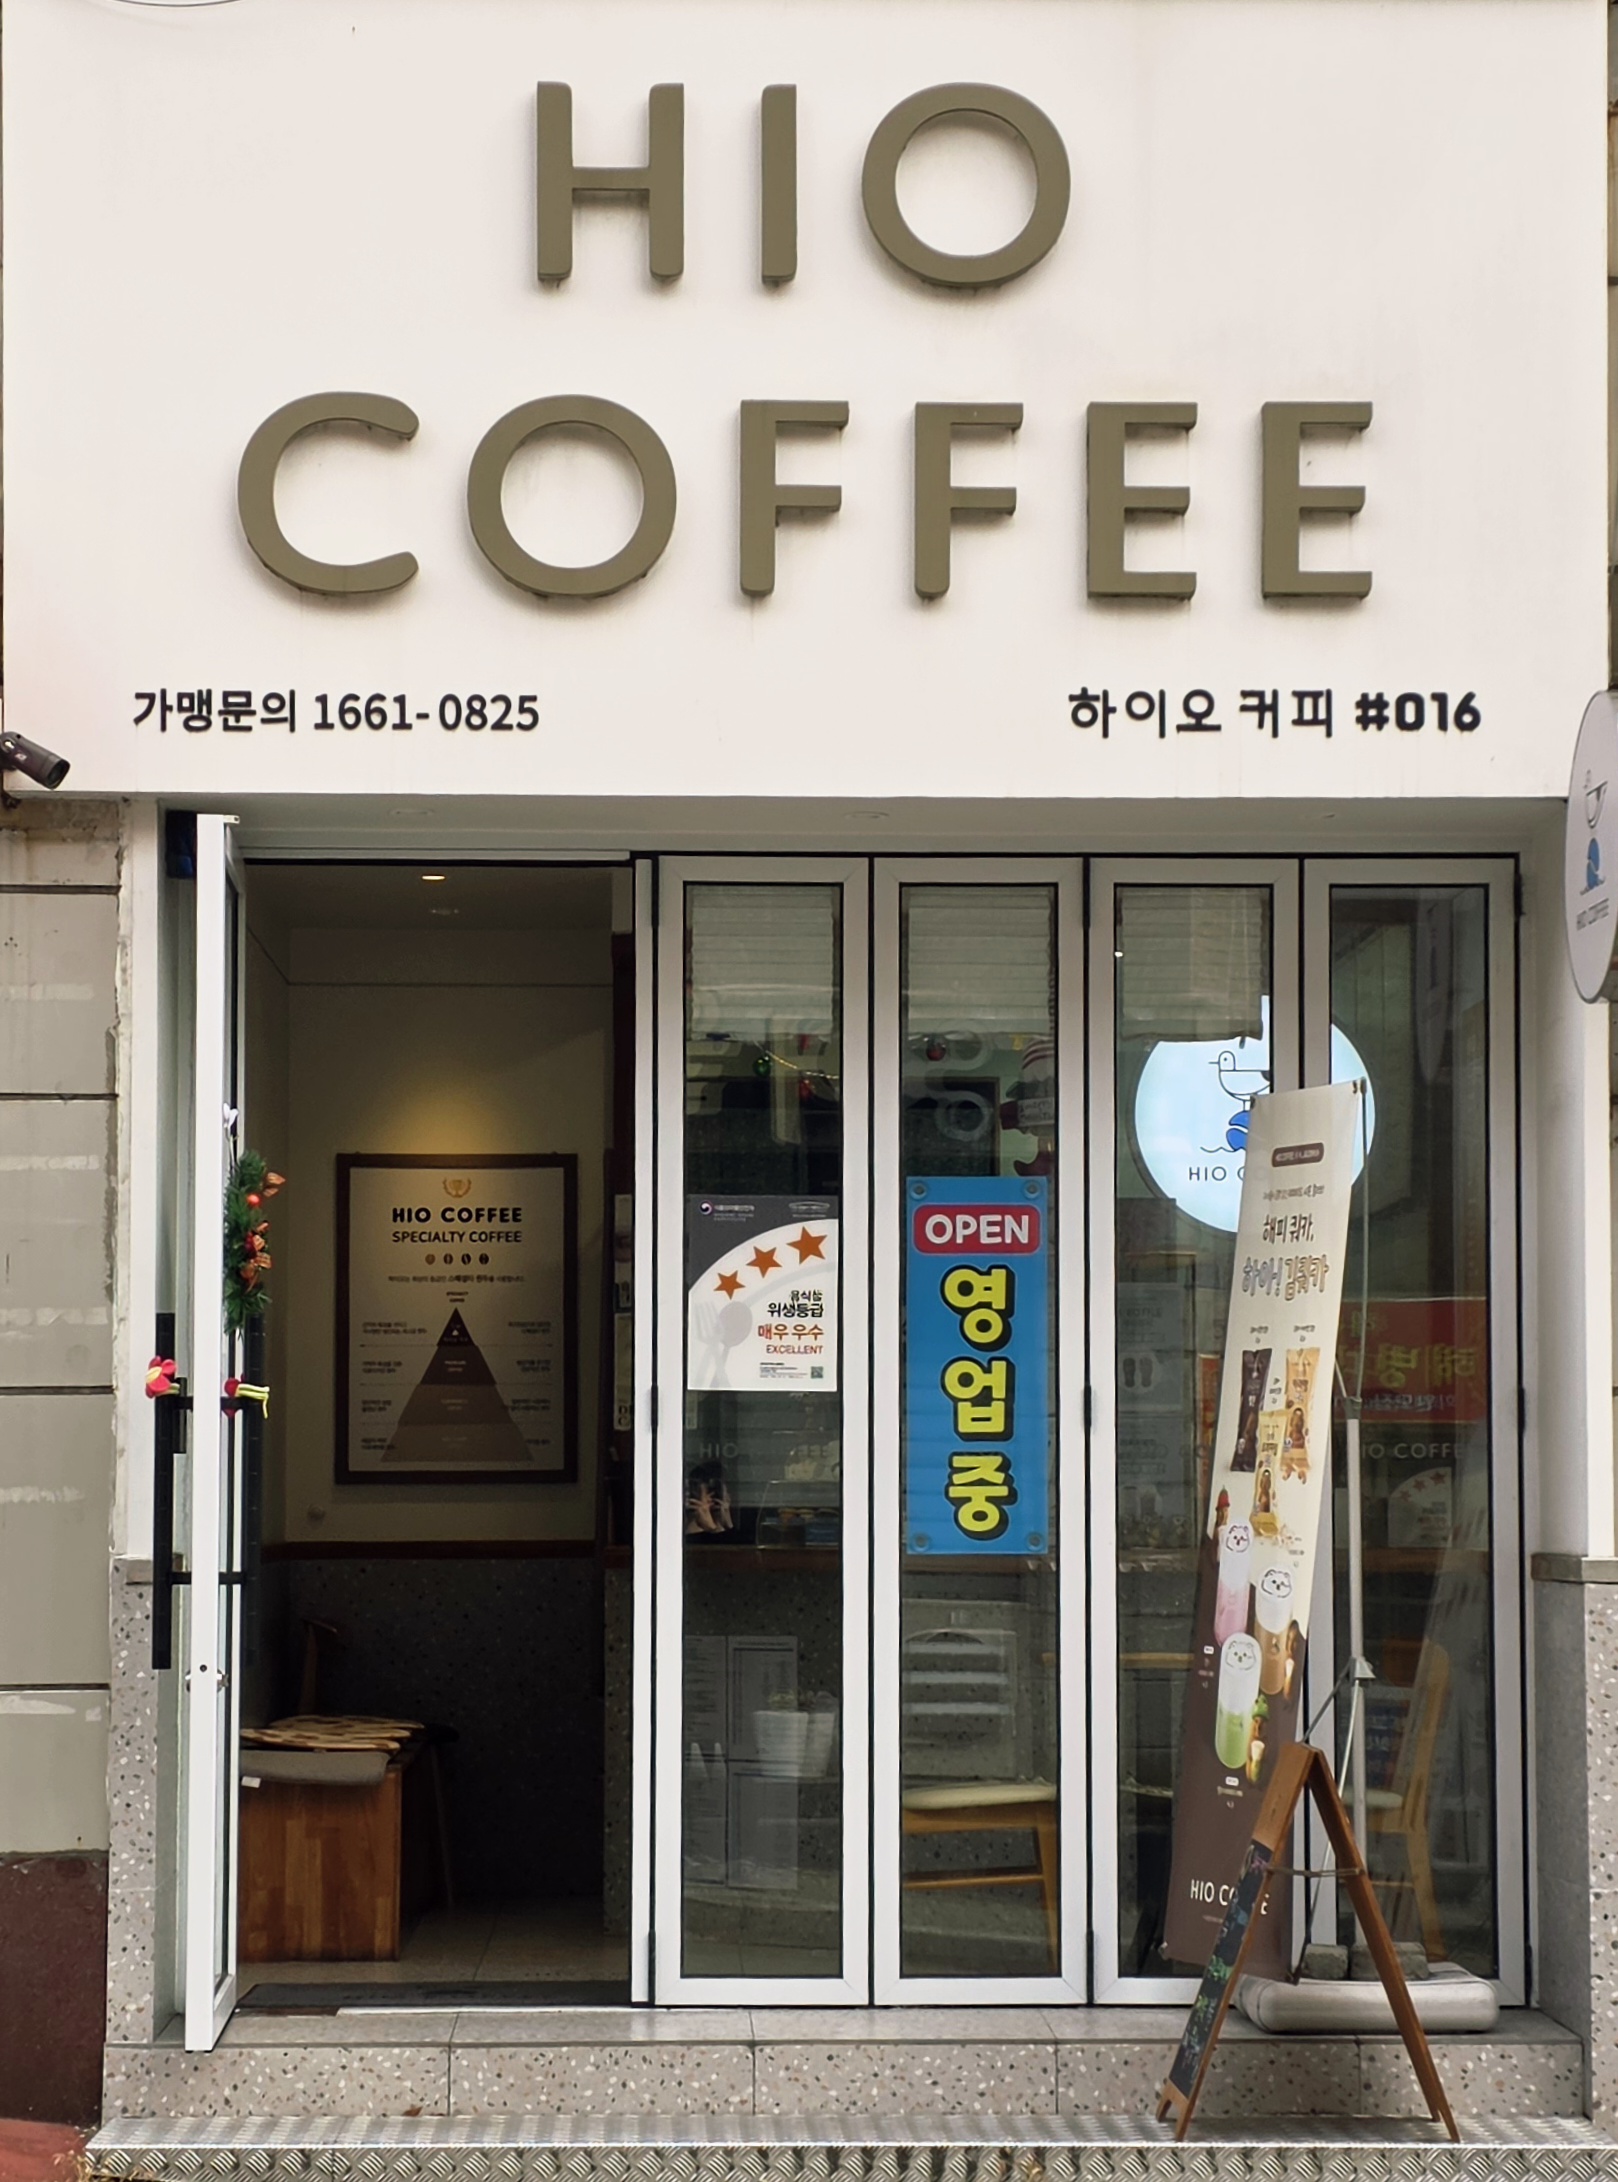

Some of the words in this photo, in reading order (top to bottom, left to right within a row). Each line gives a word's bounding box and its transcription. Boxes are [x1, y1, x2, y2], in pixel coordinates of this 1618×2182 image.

[536, 81, 1071, 288] HIO
[237, 390, 1374, 600] COFFEE
[133, 688, 297, 733] 가맹문의
[313, 693, 540, 732] 1661-0825
[1068, 687, 1222, 739] 하이오
[1239, 688, 1335, 739] 커피
[1355, 691, 1482, 733] #016
[1188, 1165, 1227, 1182] HIO
[391, 1206, 432, 1223] HIO
[440, 1206, 523, 1223] COFFEE
[391, 1230, 466, 1243] SPECIALTY
[468, 1230, 523, 1243] COFFEE
[924, 1213, 1030, 1245] OPEN
[766, 1301, 824, 1318] 위생등급
[757, 1323, 789, 1341] 매우
[791, 1323, 825, 1341] 우수
[765, 1344, 824, 1355] EXCELLENT
[943, 1266, 1012, 1537] 영업중
[1189, 1878, 1215, 1903] HIO
